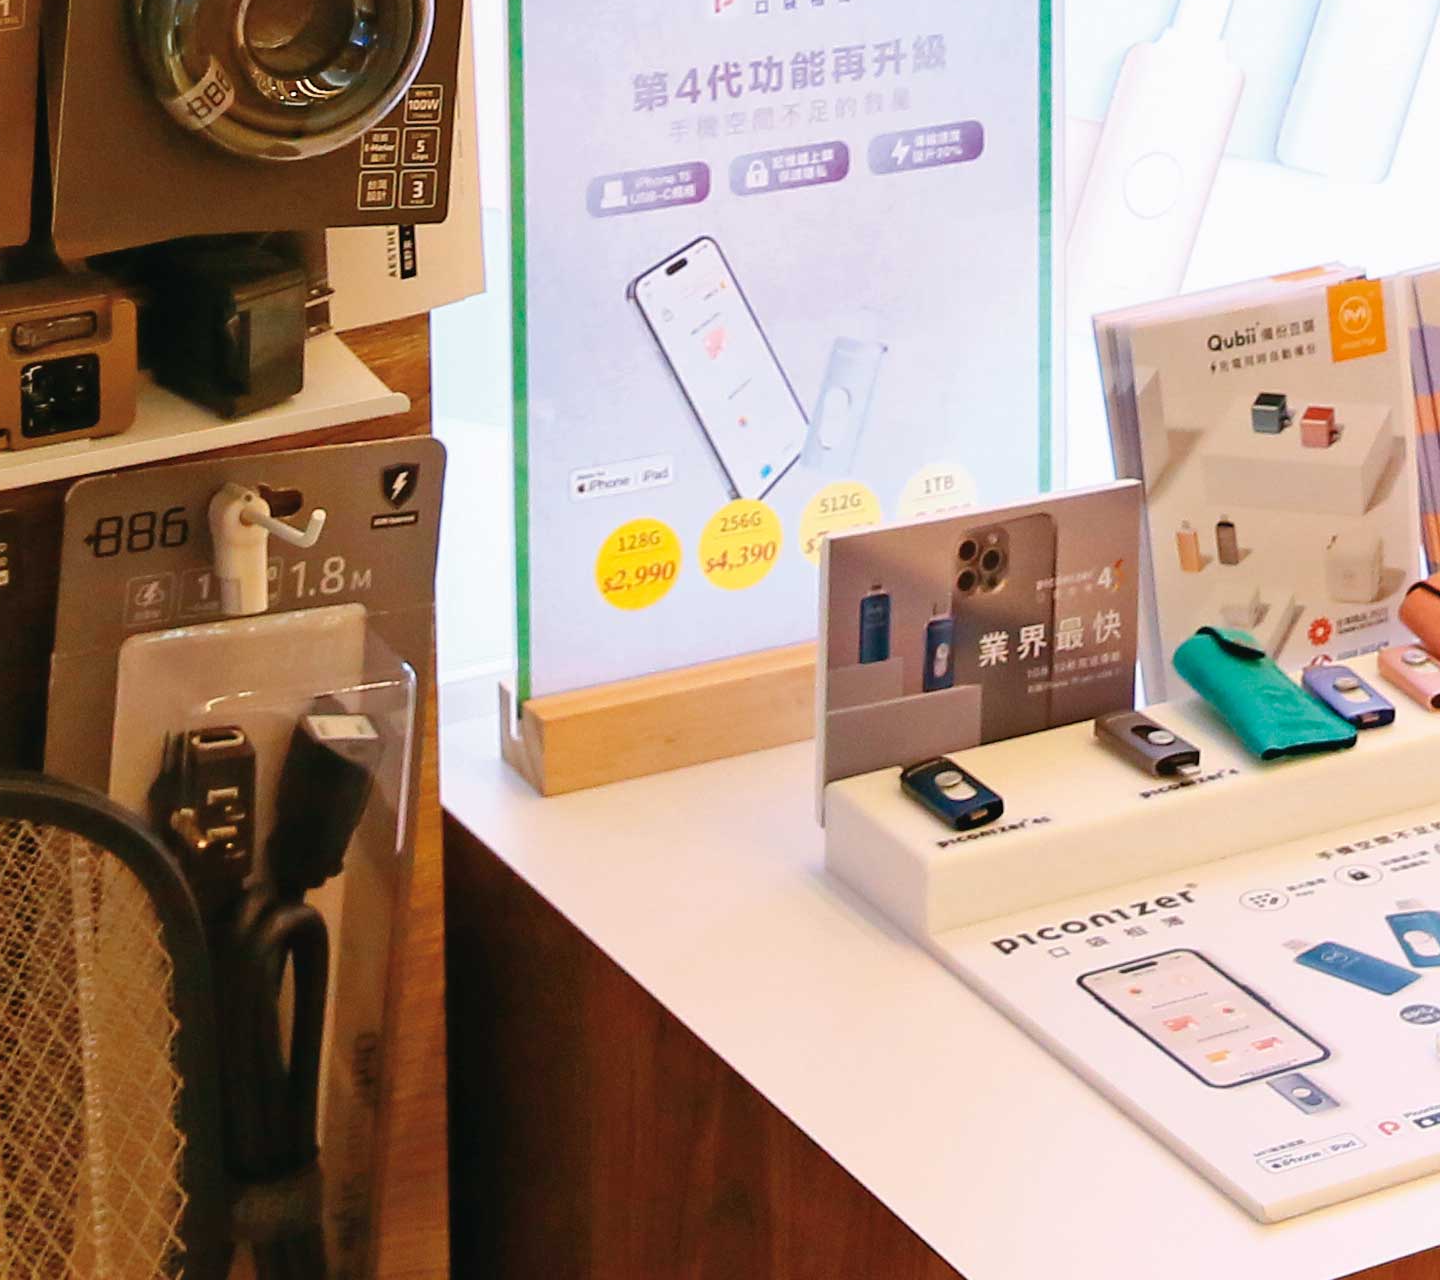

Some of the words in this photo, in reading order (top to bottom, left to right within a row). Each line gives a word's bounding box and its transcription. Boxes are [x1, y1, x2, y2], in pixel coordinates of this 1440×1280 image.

[633, 34, 947, 112] 第4代功能再升級
[418, 141, 426, 153] 5
[412, 181, 424, 198] 3
[1207, 326, 1256, 352] Qubii
[924, 475, 954, 495] 1TB
[819, 492, 862, 513] 512G
[720, 511, 762, 533] 256G
[618, 531, 660, 552] 128G
[705, 541, 776, 574] $4,390
[603, 559, 675, 593] $2,990
[979, 609, 1121, 668] 業界最快
[990, 890, 1192, 955] piconizer
